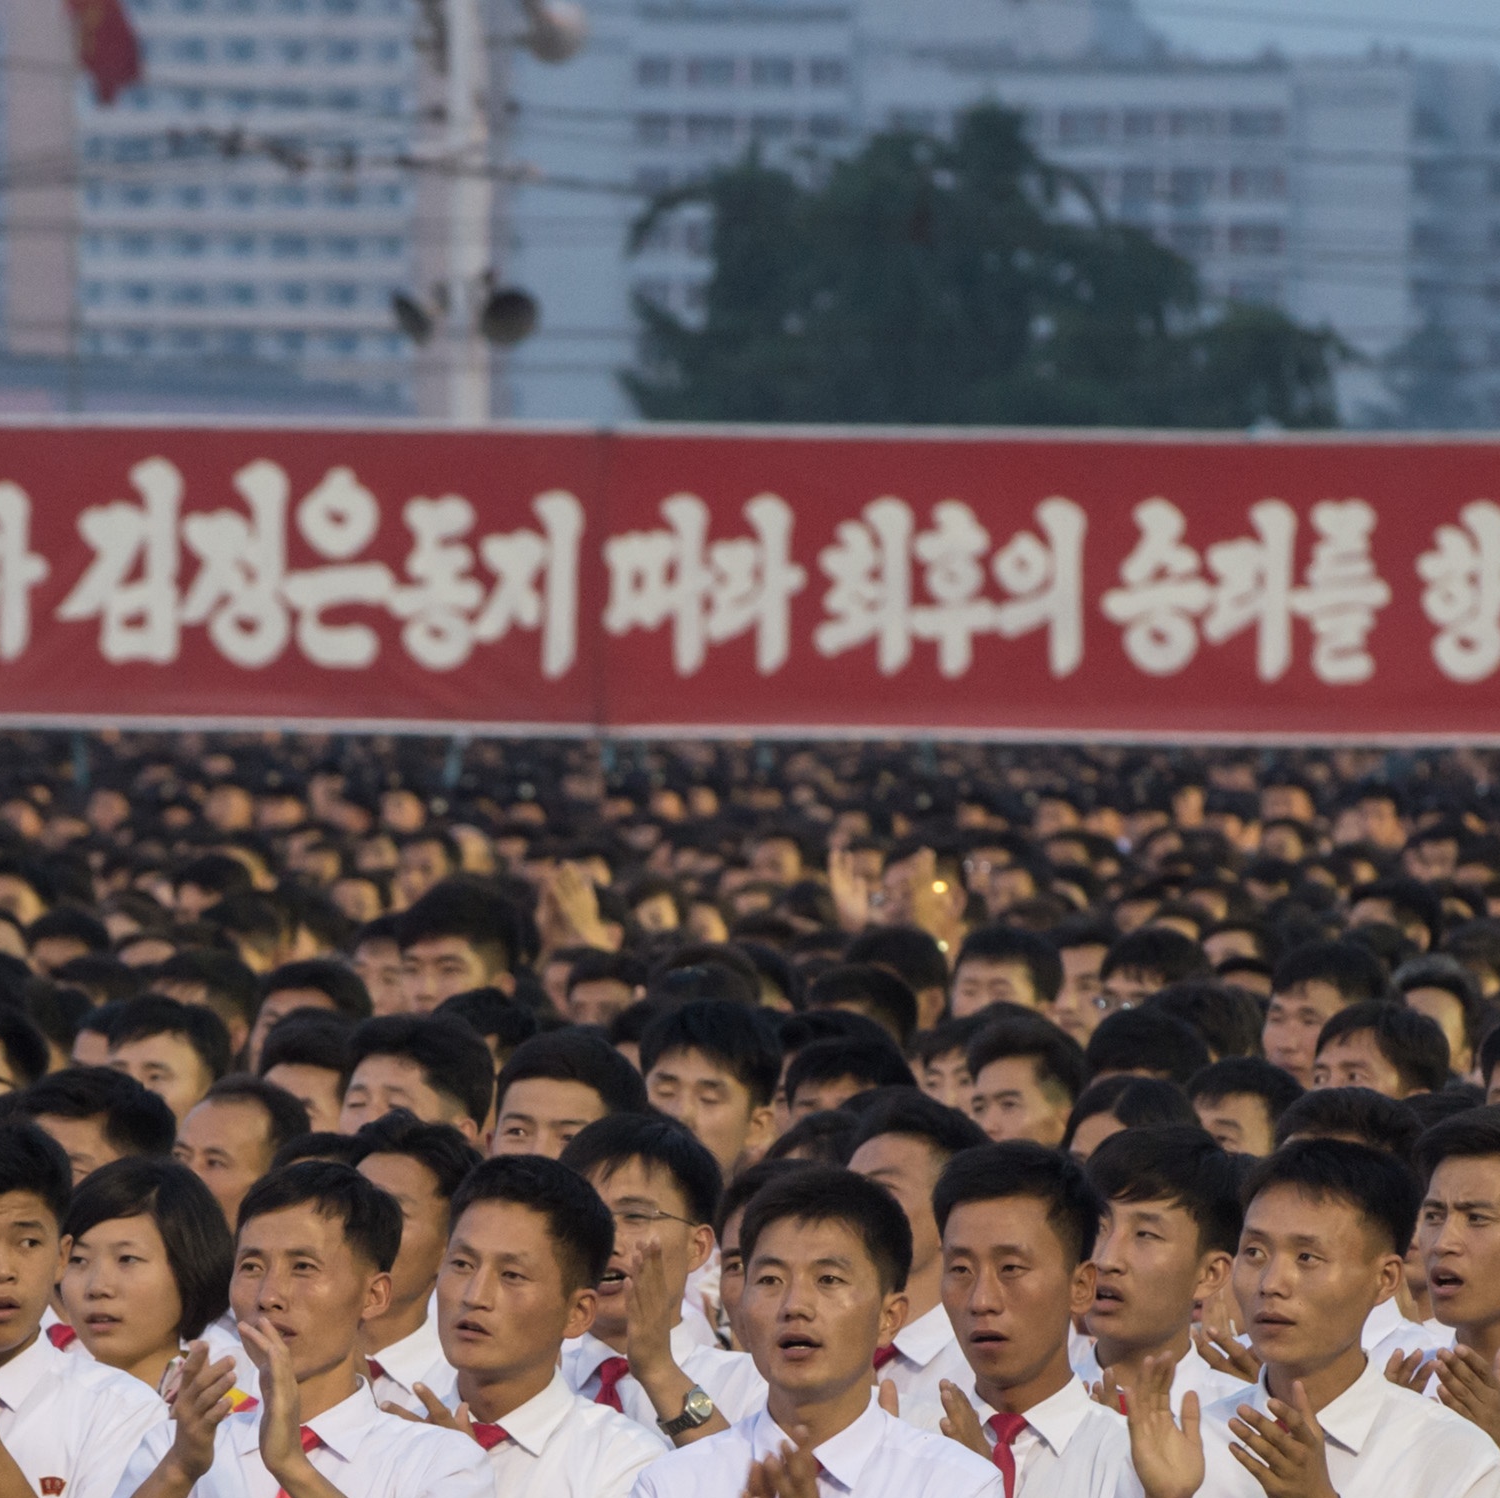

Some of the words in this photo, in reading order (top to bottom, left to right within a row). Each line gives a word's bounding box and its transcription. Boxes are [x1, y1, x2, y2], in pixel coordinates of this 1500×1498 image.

[59, 458, 584, 677] 김정은동지
[604, 493, 806, 674] 따라
[816, 496, 1087, 677] 최후의
[1102, 498, 1391, 684] 승리를
